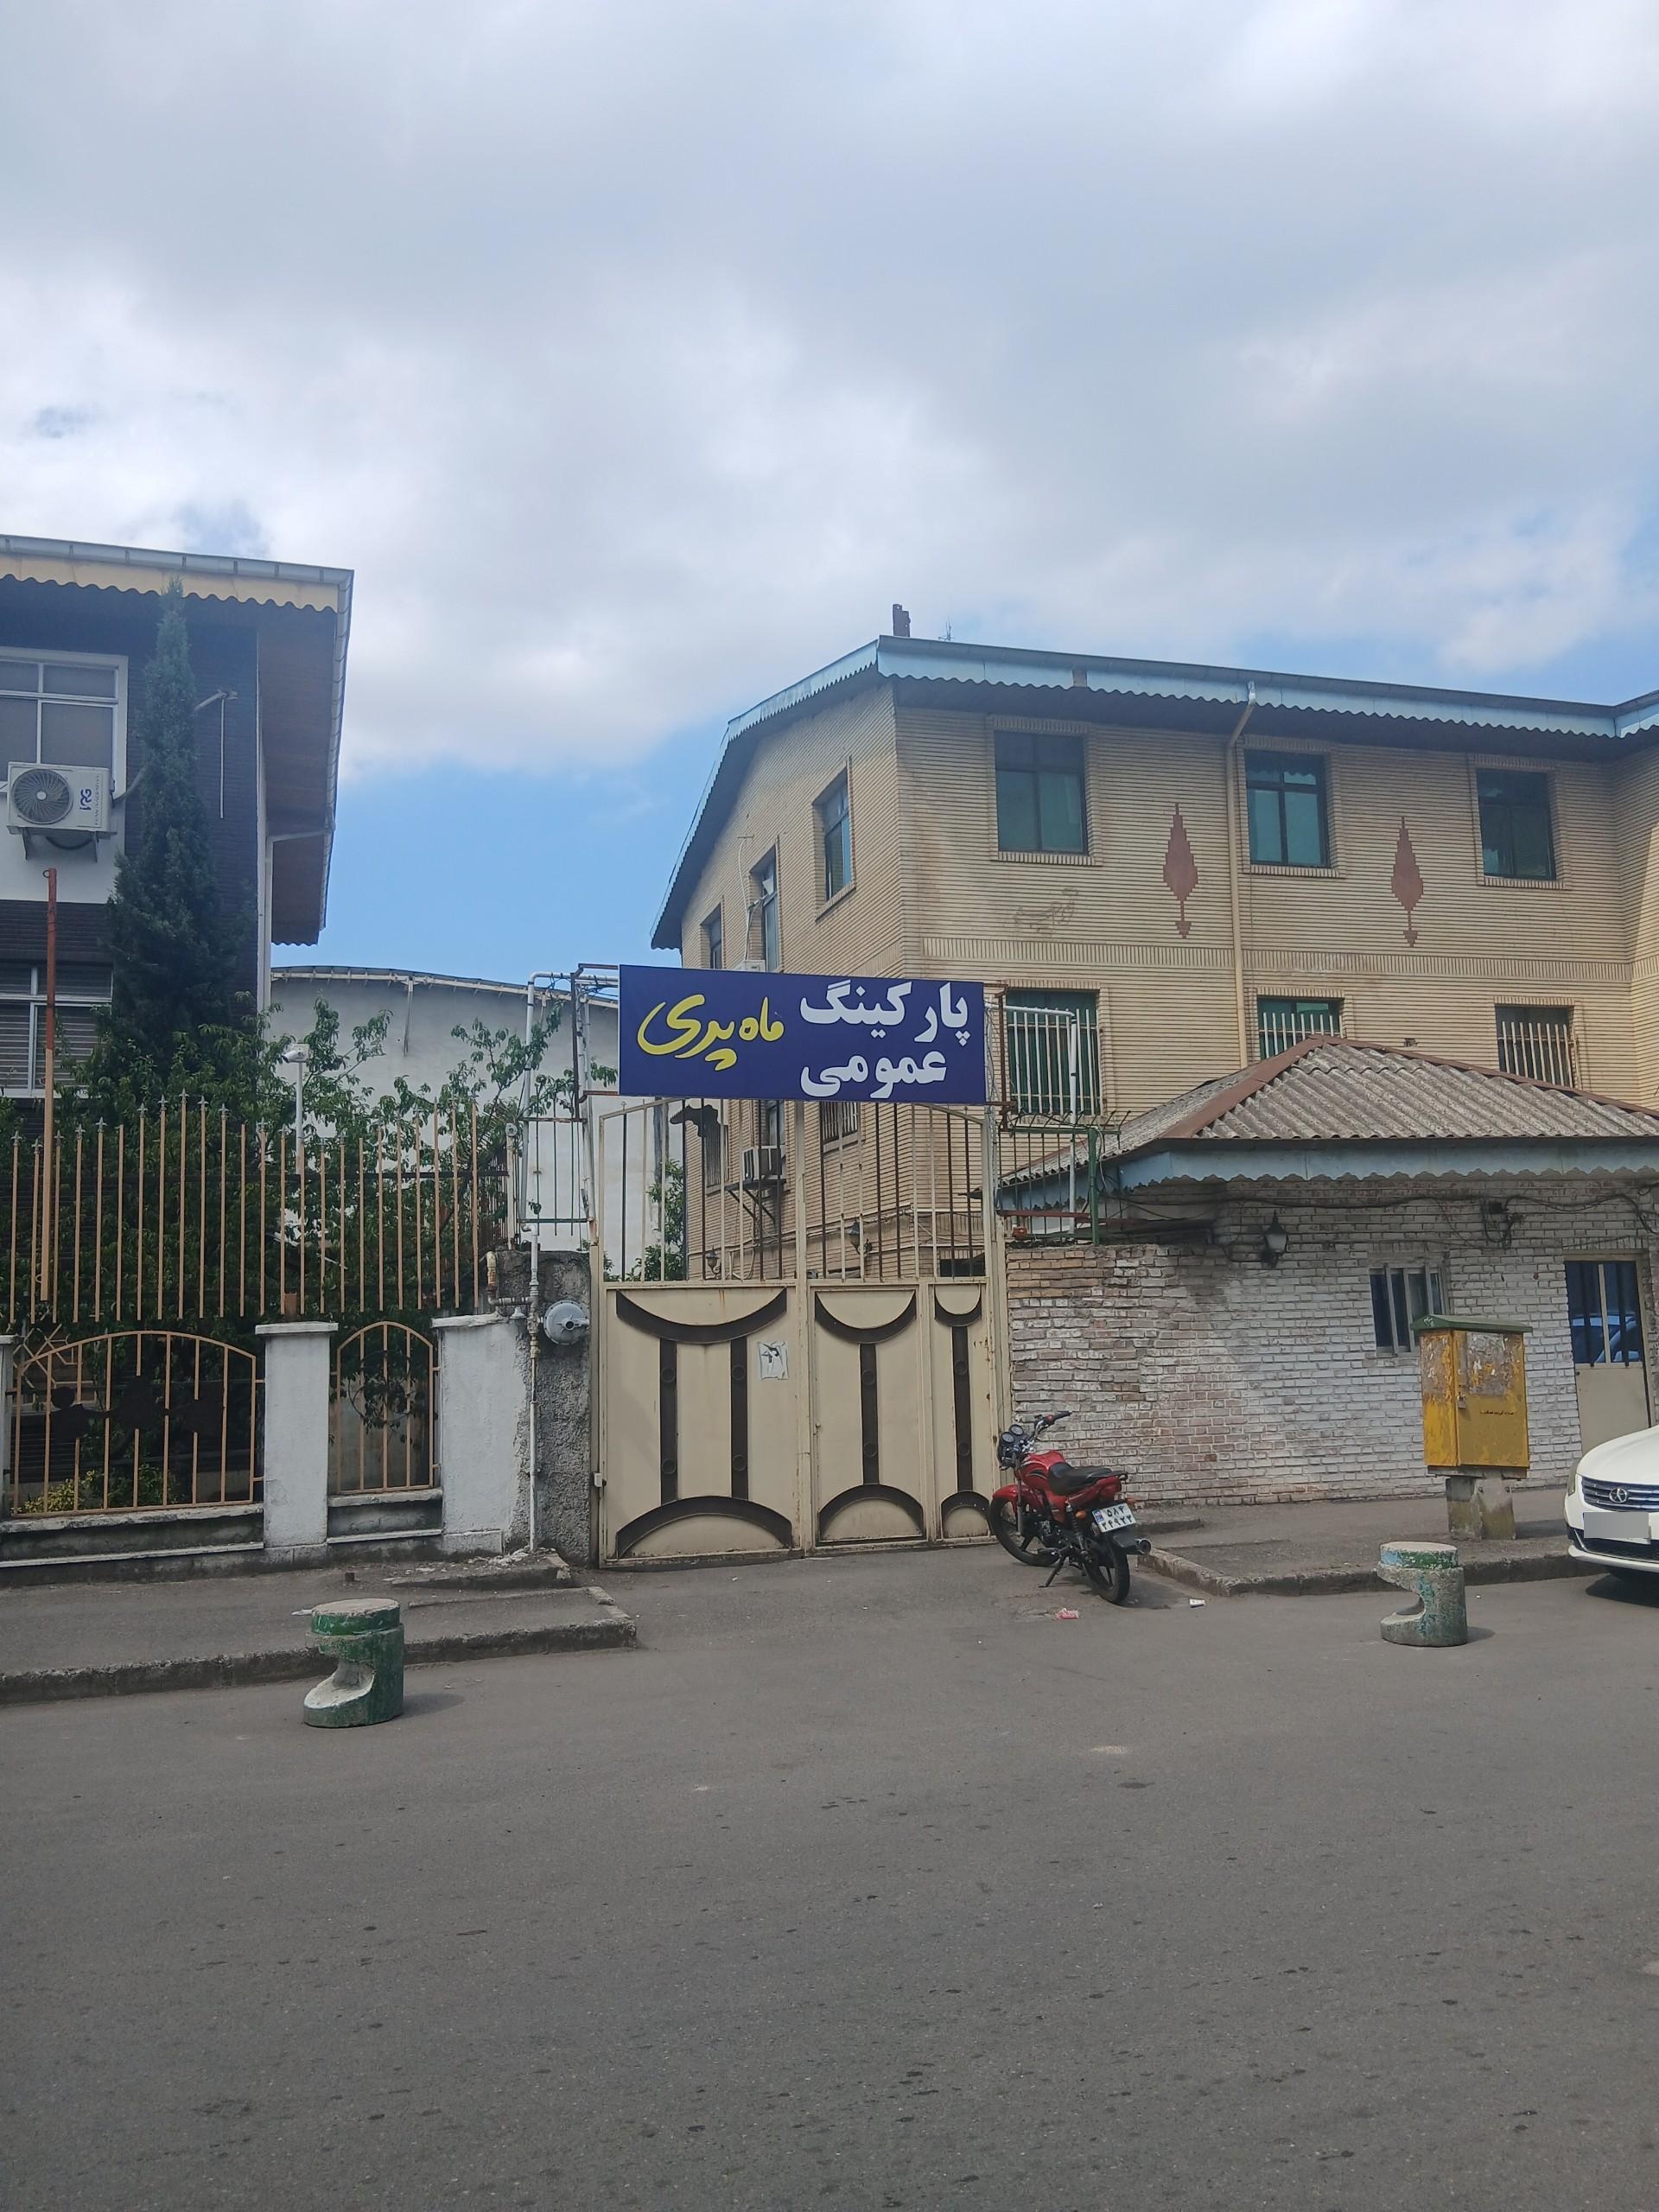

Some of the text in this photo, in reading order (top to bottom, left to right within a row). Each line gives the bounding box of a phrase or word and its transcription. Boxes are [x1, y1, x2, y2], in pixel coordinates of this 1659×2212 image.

[637, 994, 785, 1071] ماه پری
[800, 1051, 947, 1099] عمومی
